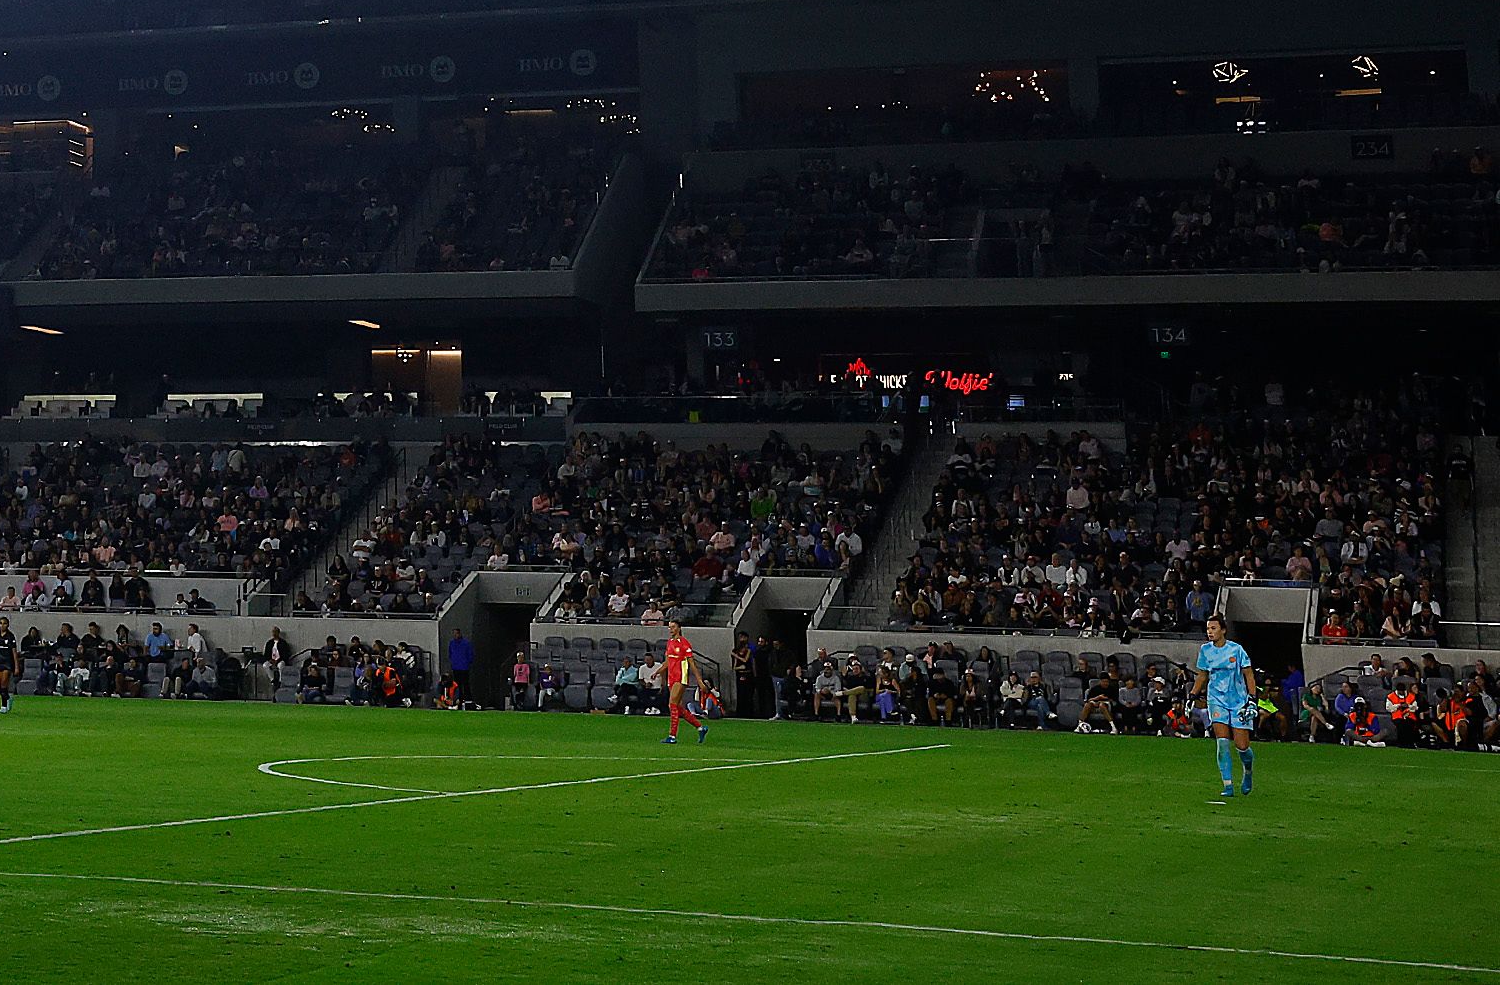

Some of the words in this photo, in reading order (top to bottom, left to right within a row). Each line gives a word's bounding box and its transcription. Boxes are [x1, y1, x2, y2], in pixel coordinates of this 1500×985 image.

[381, 63, 424, 79] BMO
[519, 57, 563, 72] BMO
[118, 78, 159, 91] BMO
[247, 70, 289, 85] BMO
[1356, 142, 1389, 156] 234
[704, 332, 735, 346] 133
[1151, 328, 1188, 343] 134
